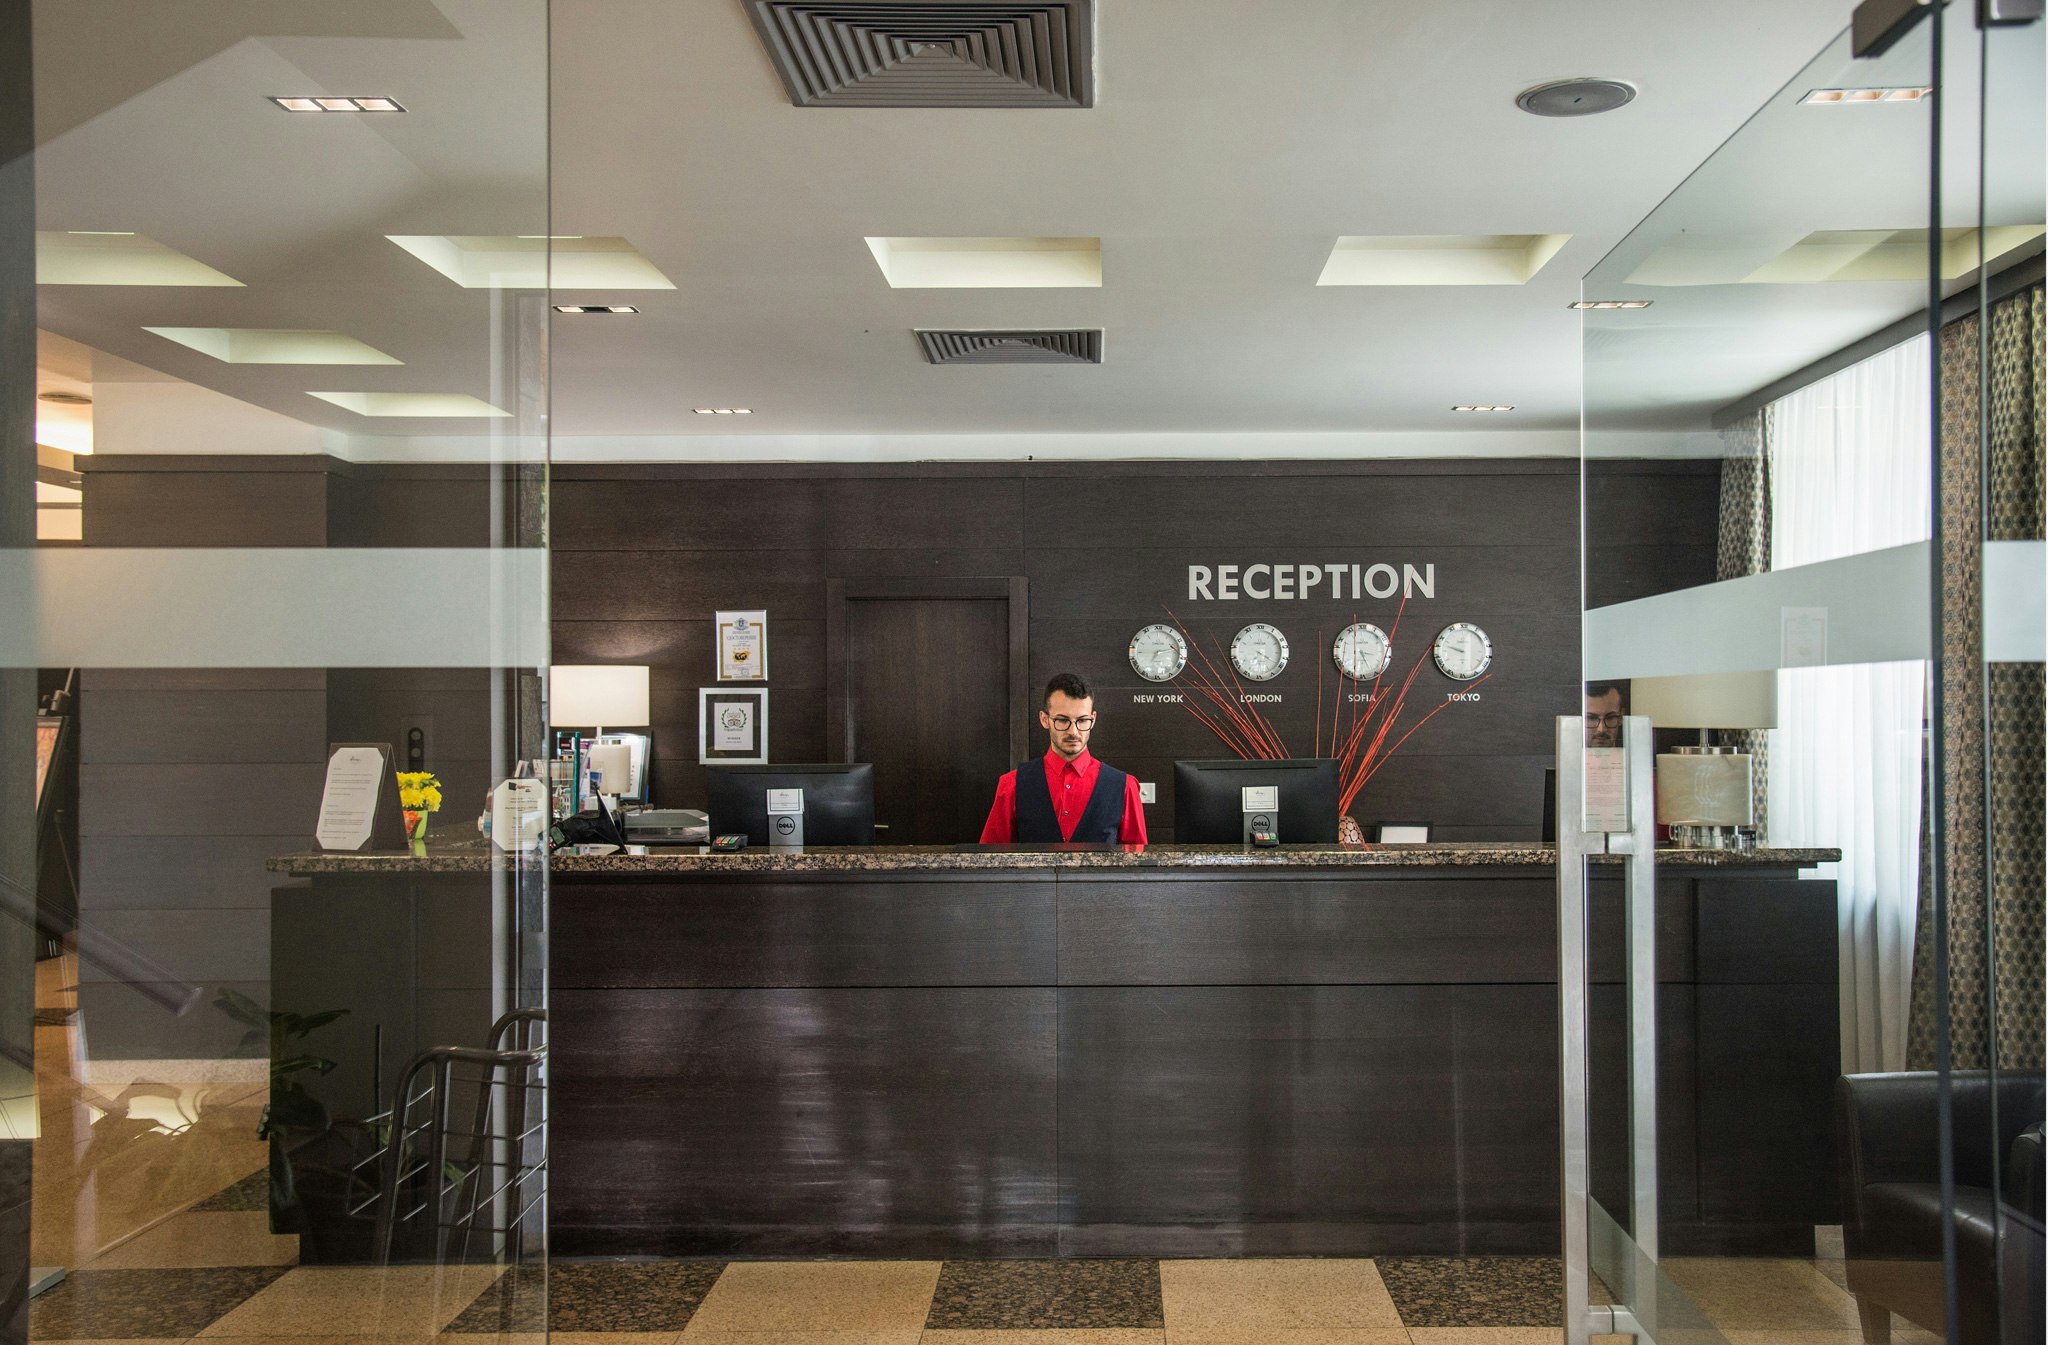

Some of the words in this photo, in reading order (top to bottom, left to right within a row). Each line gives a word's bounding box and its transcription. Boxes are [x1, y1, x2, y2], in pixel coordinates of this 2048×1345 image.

[1188, 563, 1436, 601] RECEPTION
[1133, 694, 1155, 703] NEW
[1157, 694, 1184, 703] YORK
[1240, 694, 1282, 703] LONDON
[1348, 693, 1377, 703] SOFIA
[1447, 692, 1481, 702] TOKYO
